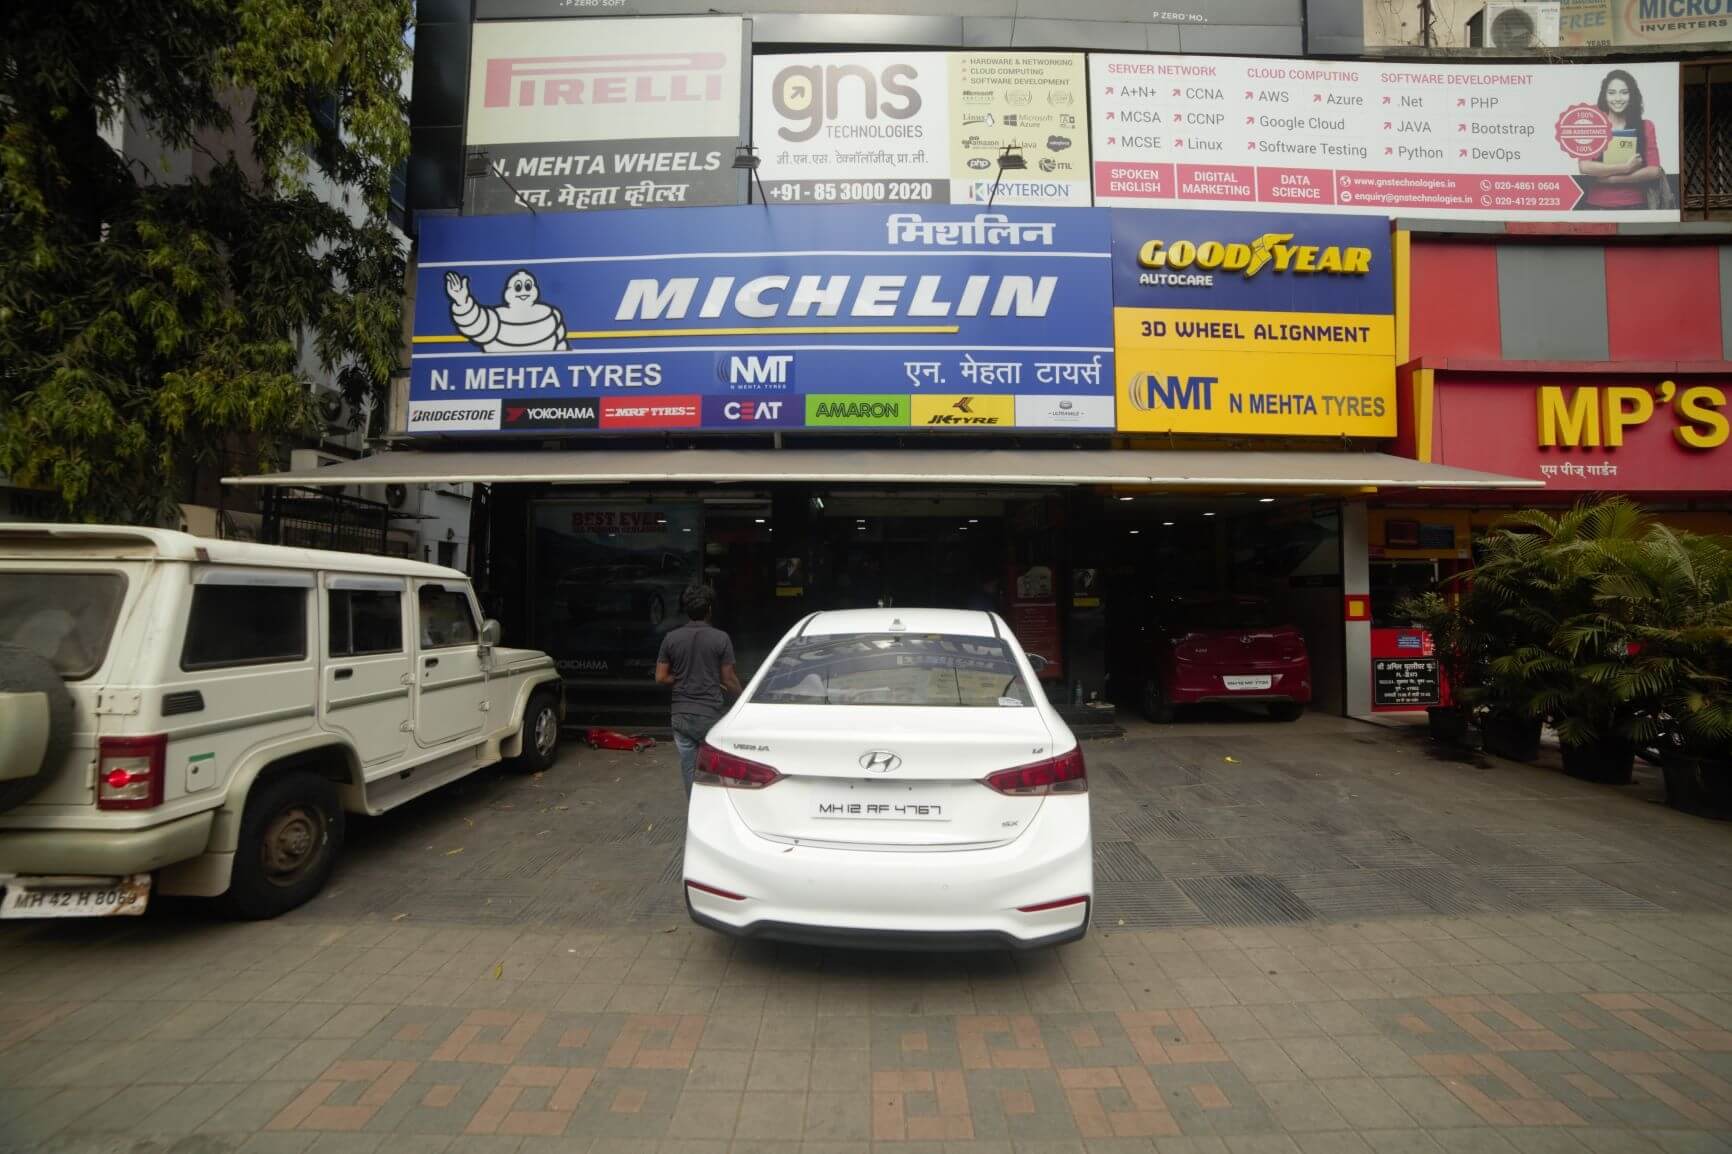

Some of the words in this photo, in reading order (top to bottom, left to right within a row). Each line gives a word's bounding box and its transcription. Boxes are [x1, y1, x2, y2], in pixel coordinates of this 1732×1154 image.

[1639, 0, 1732, 19] MICRO
[1640, 20, 1728, 32] INVERTERS
[1108, 64, 1155, 74] SERVER
[1158, 65, 1216, 76] NETWORK
[1247, 68, 1286, 79] CLOUD
[1288, 70, 1359, 82] COMPUTING
[484, 52, 727, 108] PIRELLI
[1381, 72, 1444, 84] SOFTWARE
[1447, 74, 1534, 85] DEVELOPMENT
[1120, 86, 1157, 98] A+N+
[1186, 88, 1224, 100] CCNA
[1258, 90, 1289, 102] AWS
[772, 64, 922, 143] gns
[1326, 94, 1364, 106] Azure
[1397, 96, 1424, 108] .Net
[1470, 97, 1499, 109] PHP
[1120, 110, 1162, 123] MCSA
[1187, 113, 1224, 125] CCNP
[1260, 116, 1305, 130] Google
[1308, 118, 1345, 130] Cloud
[826, 125, 923, 138] TECHNOLOGIES
[1396, 120, 1432, 133] JAVA
[1472, 122, 1535, 137] Bootstrap
[1122, 136, 1161, 148] MCSE
[1188, 138, 1223, 150] Linux
[1259, 140, 1317, 154] Software
[1320, 142, 1368, 158] Testing
[1398, 146, 1444, 160] Python
[1472, 148, 1521, 162] DevOps
[516, 154, 606, 177] MEHTA
[614, 152, 722, 174] WHEELS
[1111, 168, 1160, 180] SPOKEN
[1194, 172, 1238, 183] DIGITAL
[1280, 174, 1311, 186] DATA
[987, 183, 1069, 197] KRYTERION
[1110, 182, 1161, 194] ENGLISH
[1182, 184, 1250, 196] MARKETING
[1354, 178, 1456, 188] www.gnstechnologies.in
[514, 189, 552, 208] एन.
[558, 184, 620, 209] मेहता
[770, 182, 801, 200] +91
[814, 182, 837, 200] 85
[840, 182, 886, 200] 3000
[888, 182, 932, 200] 2020
[1272, 186, 1320, 199] SCIENCE
[886, 213, 1056, 245] मिशलिन
[1139, 274, 1214, 288] AUTOCARE
[614, 274, 1058, 321] MICHELIN
[1141, 321, 1167, 338] 3D
[1176, 322, 1245, 340] WHEEL
[1254, 324, 1370, 342] ALIGNMENT
[730, 355, 794, 384] NMT
[904, 362, 946, 386] एन.
[960, 353, 1022, 384] मेहता
[1034, 354, 1102, 384] टायर्स
[430, 369, 456, 391] N.
[464, 366, 559, 390] MEHTA
[567, 364, 662, 388] TYRES
[1146, 375, 1218, 410] NMT
[1229, 393, 1243, 414] N
[1250, 394, 1316, 415] MEHTA
[1322, 396, 1386, 417] TYRES
[411, 408, 496, 422] BRIDGESTONE
[527, 407, 595, 420] YOKOHAMA
[614, 407, 650, 417] MRF
[651, 406, 686, 416] TYRES
[724, 402, 783, 420] CEAT
[816, 402, 899, 418] AMARON
[573, 512, 616, 526] BEST
[820, 804, 843, 814] MH
[848, 804, 861, 814] 12
[866, 804, 890, 814] RF
[894, 804, 941, 815] 4767
[14, 892, 44, 908] MH
[49, 892, 72, 906] 42
[76, 892, 91, 906] H
